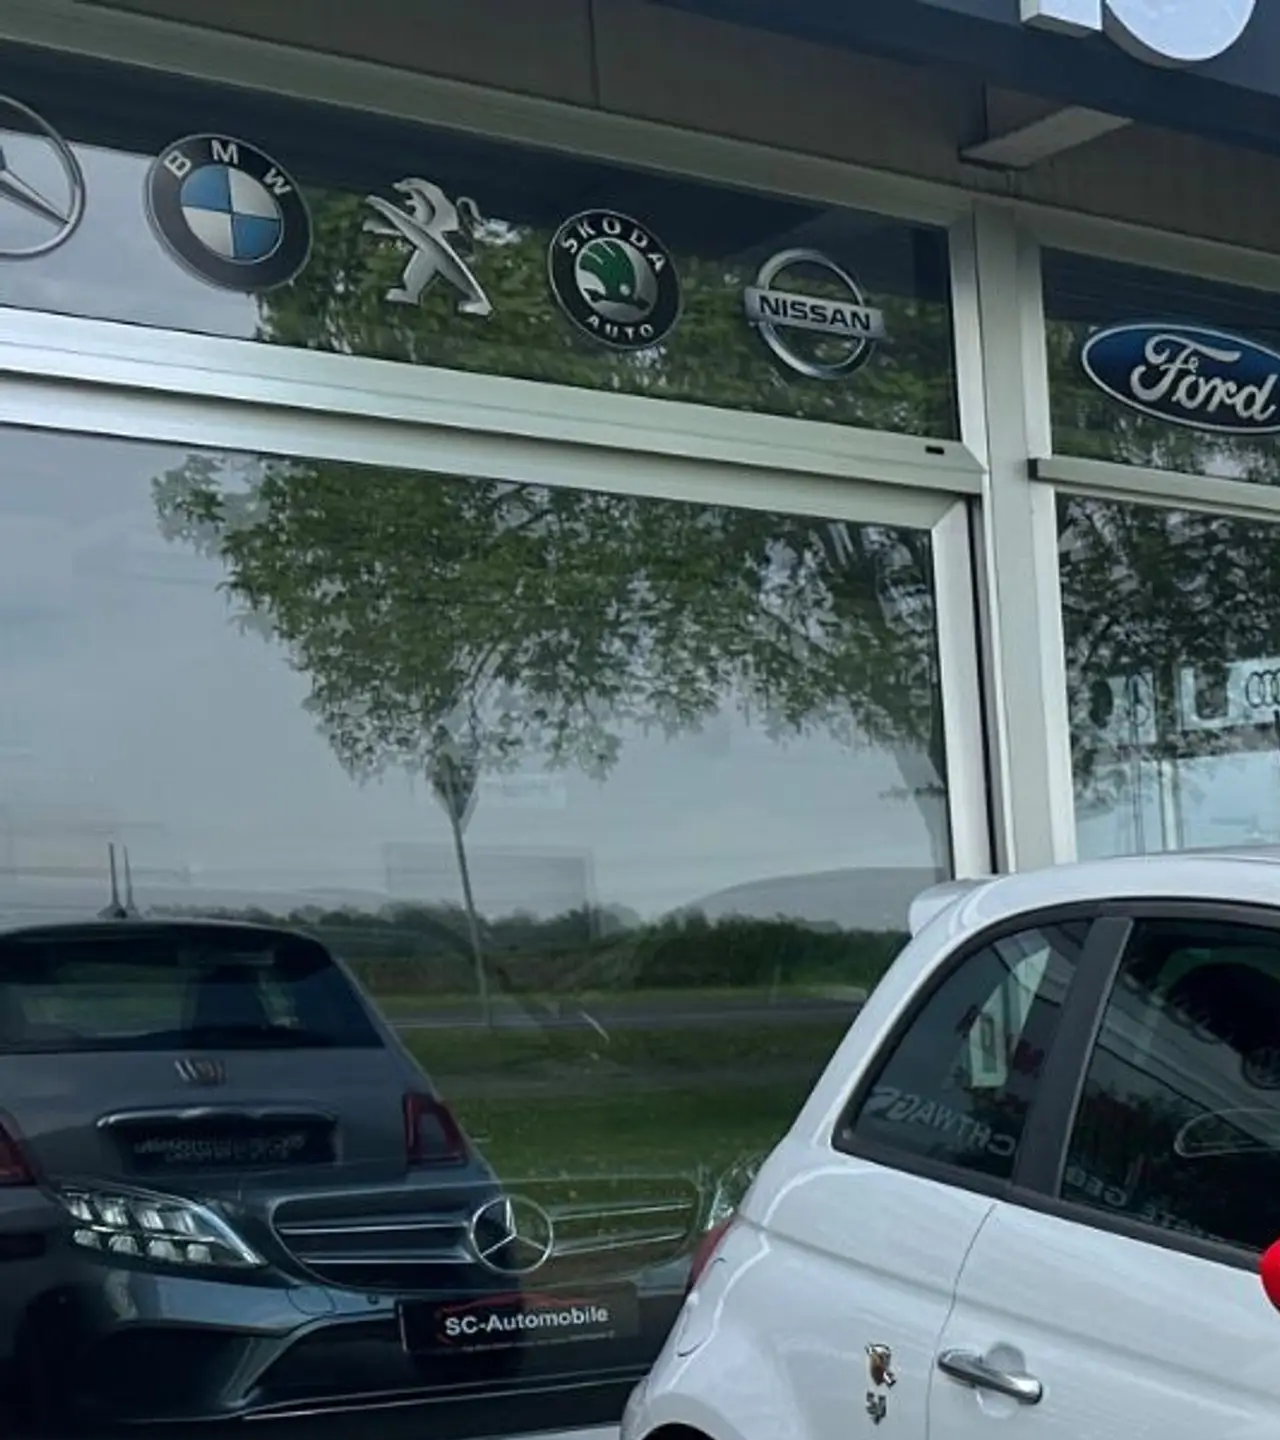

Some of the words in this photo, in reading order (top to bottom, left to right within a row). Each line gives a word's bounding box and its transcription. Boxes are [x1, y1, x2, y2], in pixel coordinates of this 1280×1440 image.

[163, 138, 293, 197] BMW
[585, 313, 655, 340] AUTO
[758, 295, 872, 332] NISSAN
[1129, 333, 1280, 421] Ford
[444, 1305, 610, 1338] SC-Automobile
